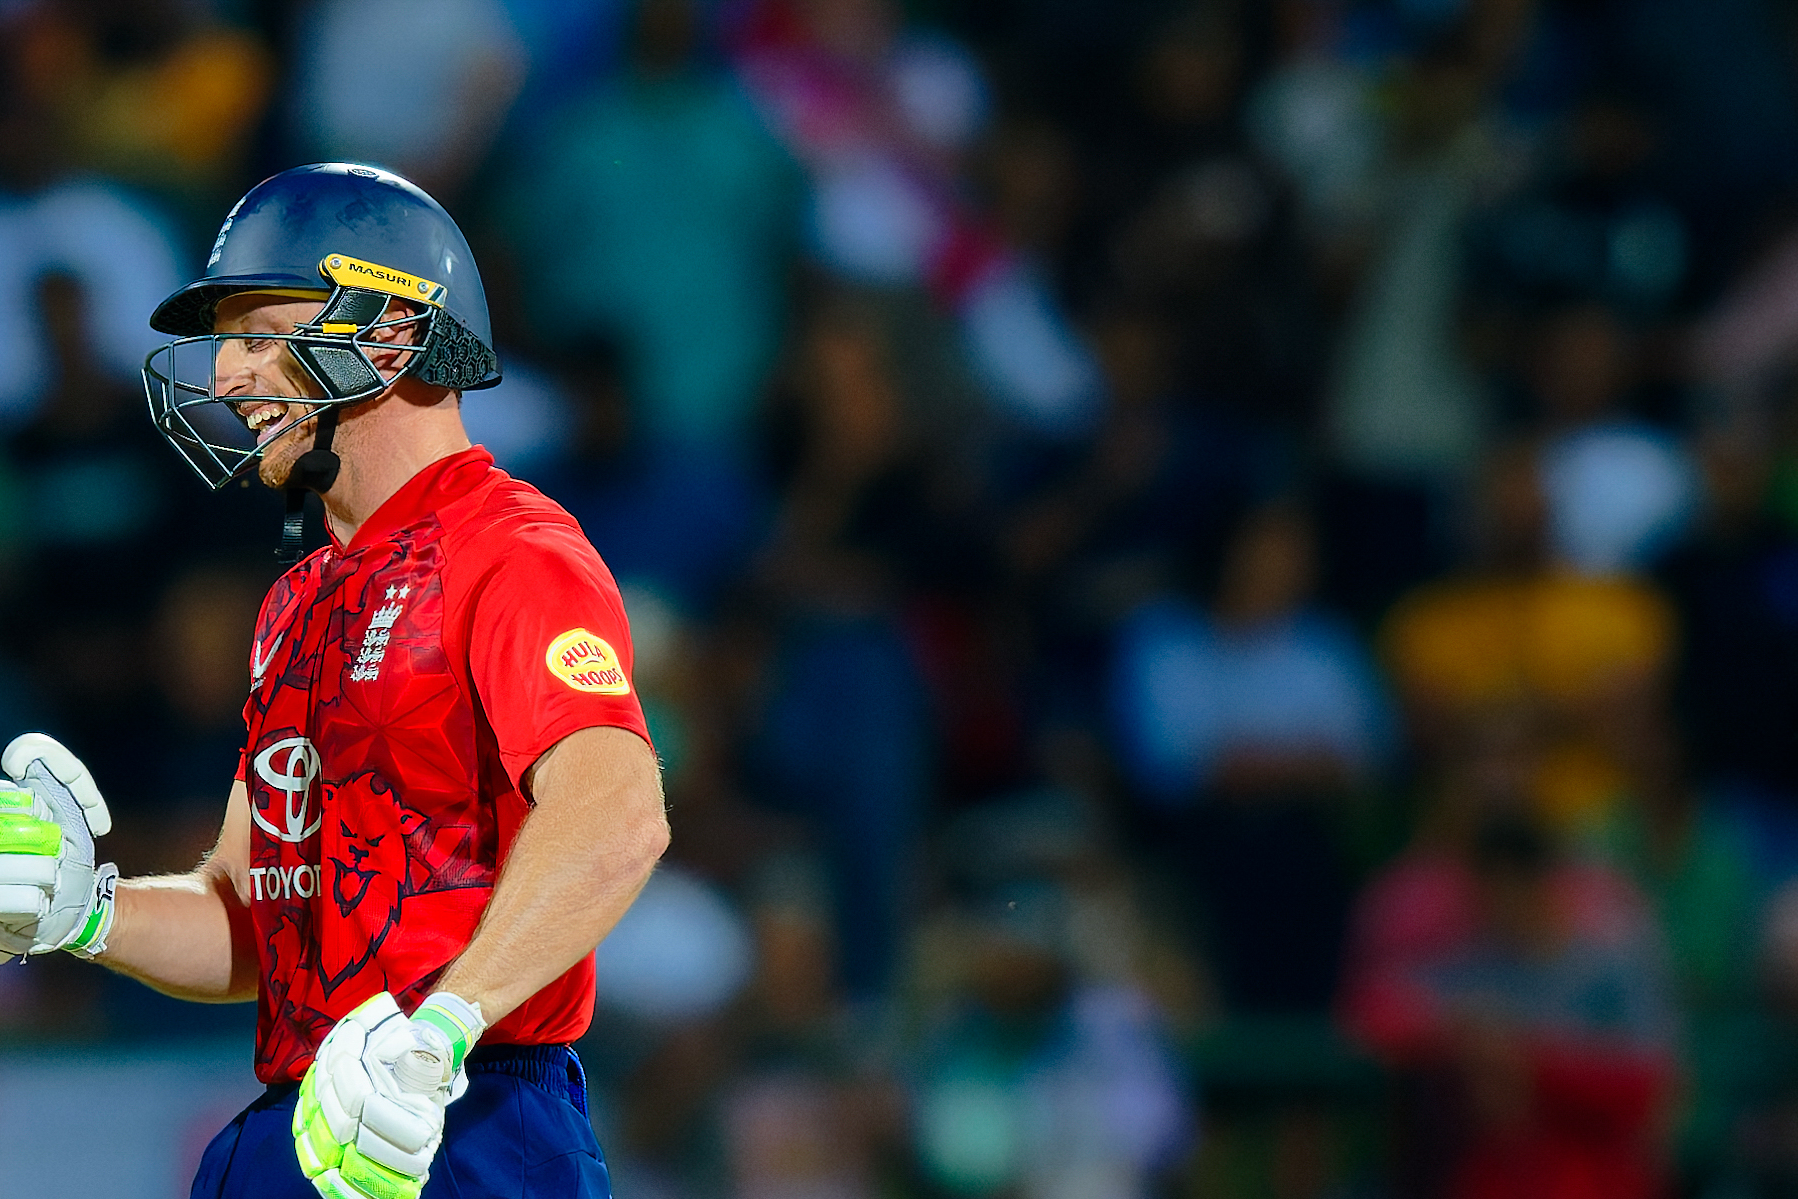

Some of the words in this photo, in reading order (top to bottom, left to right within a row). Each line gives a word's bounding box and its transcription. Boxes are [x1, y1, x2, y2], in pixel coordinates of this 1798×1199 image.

[349, 263, 411, 287] MASURI
[561, 640, 606, 667] HULA
[571, 667, 623, 685] HOOPS
